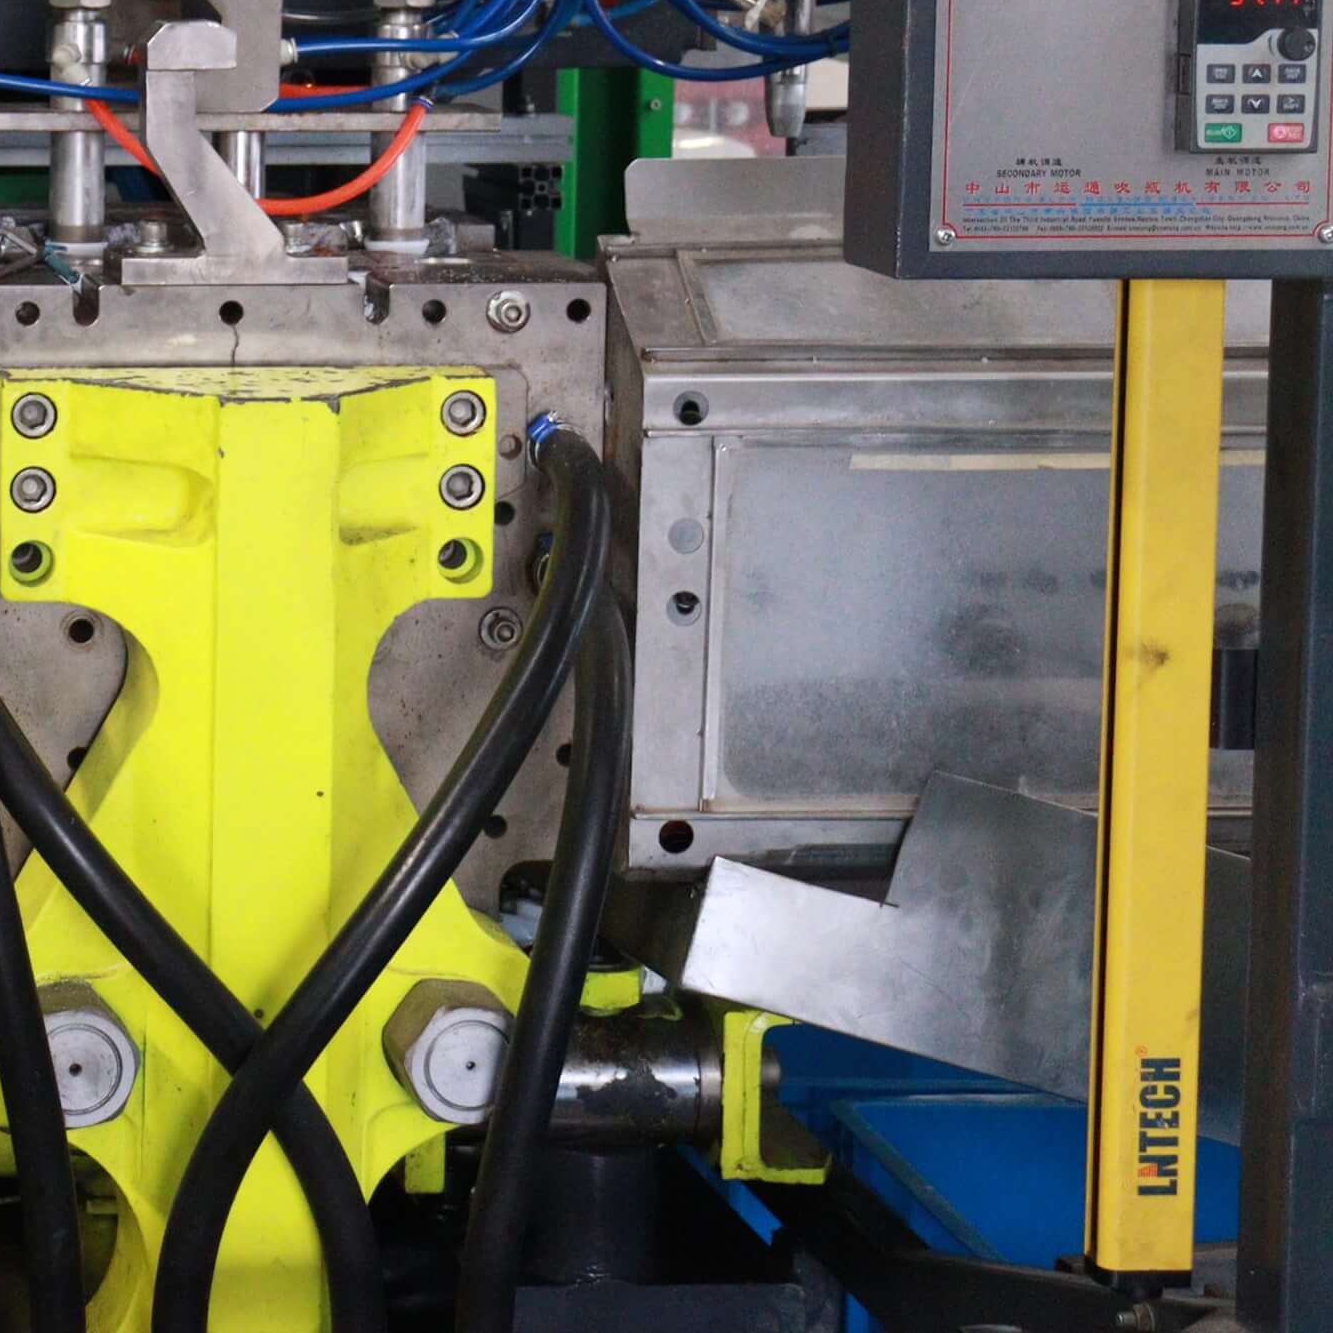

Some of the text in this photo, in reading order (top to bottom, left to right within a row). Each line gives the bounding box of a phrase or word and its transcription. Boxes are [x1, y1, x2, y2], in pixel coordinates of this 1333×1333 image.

[996, 169, 1082, 178] SECONDARY MOTOR
[1205, 168, 1270, 177] MAIN MOTOR
[964, 180, 1311, 195] 中山市运通吹瓶机有限公司
